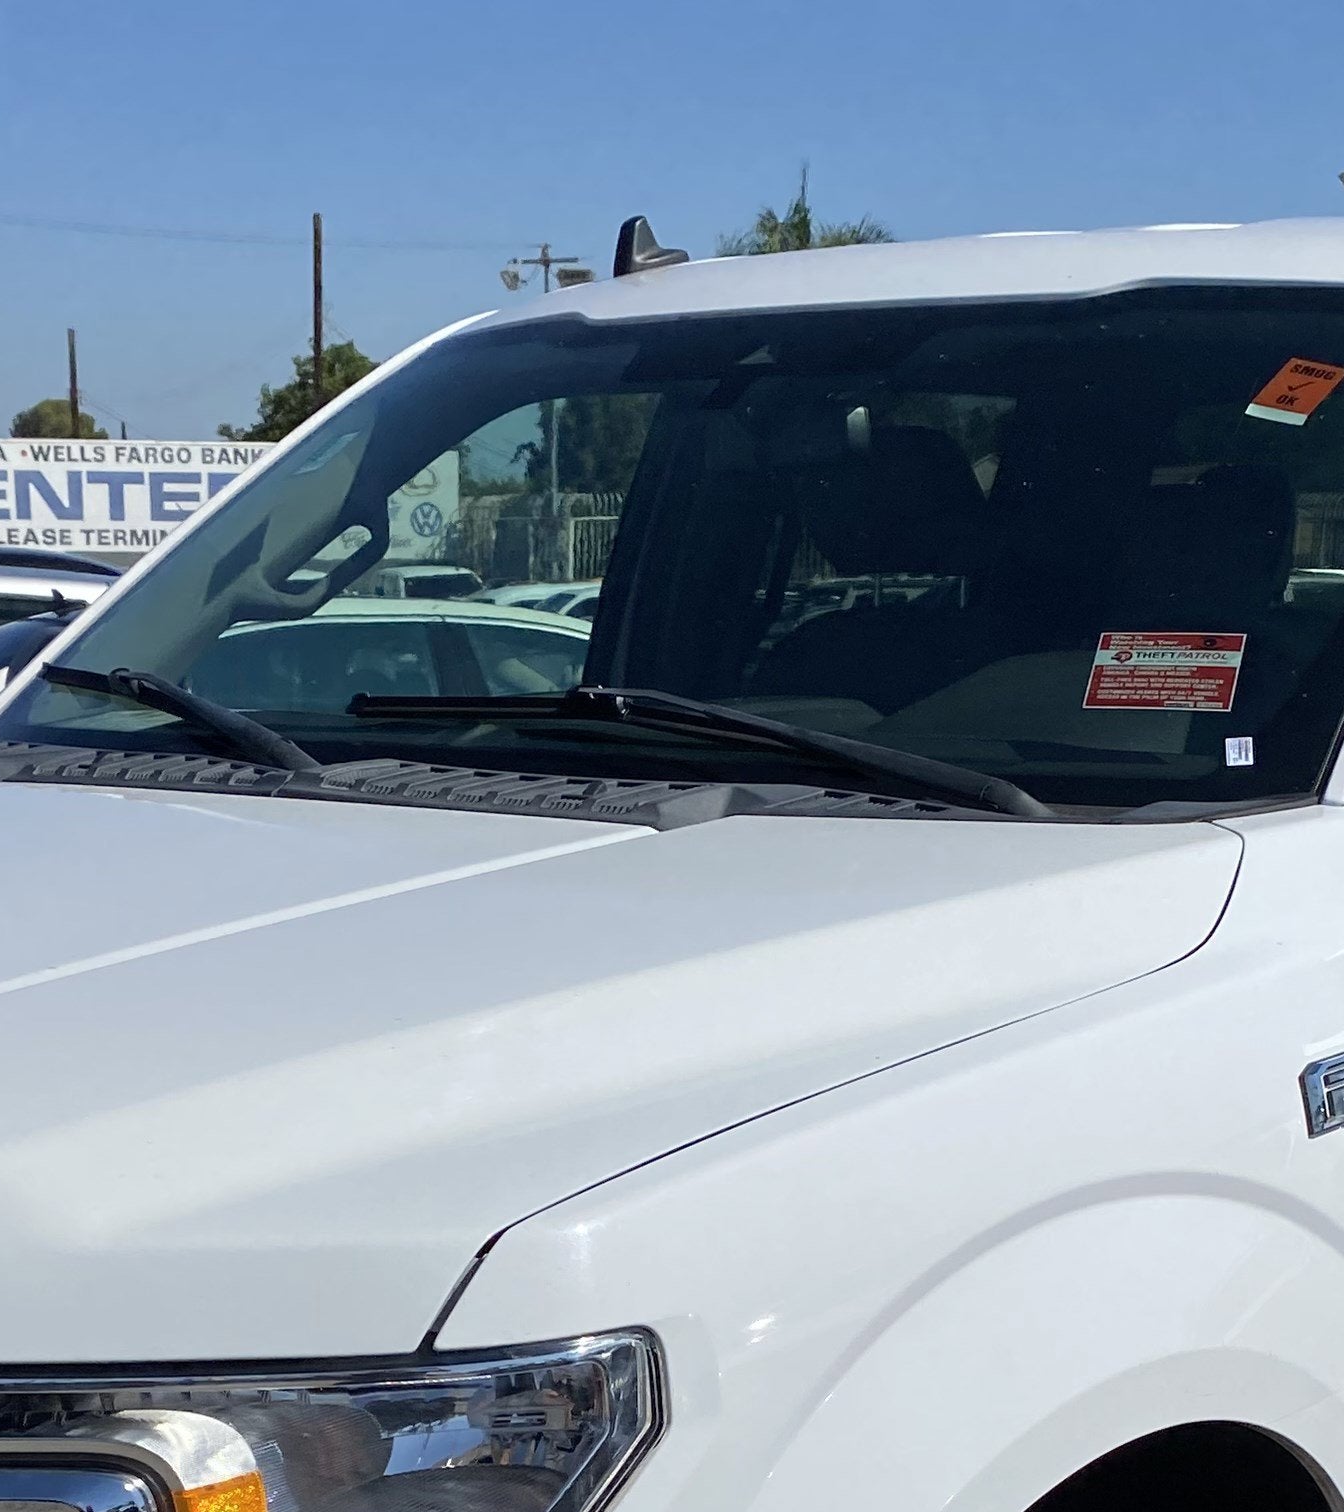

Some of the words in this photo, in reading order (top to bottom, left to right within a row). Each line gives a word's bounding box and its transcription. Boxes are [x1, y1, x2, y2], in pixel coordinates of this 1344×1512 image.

[1289, 364, 1337, 381] SMOG
[1276, 394, 1299, 407] OK
[30, 445, 106, 463] WELLS
[115, 446, 193, 465] FARGO
